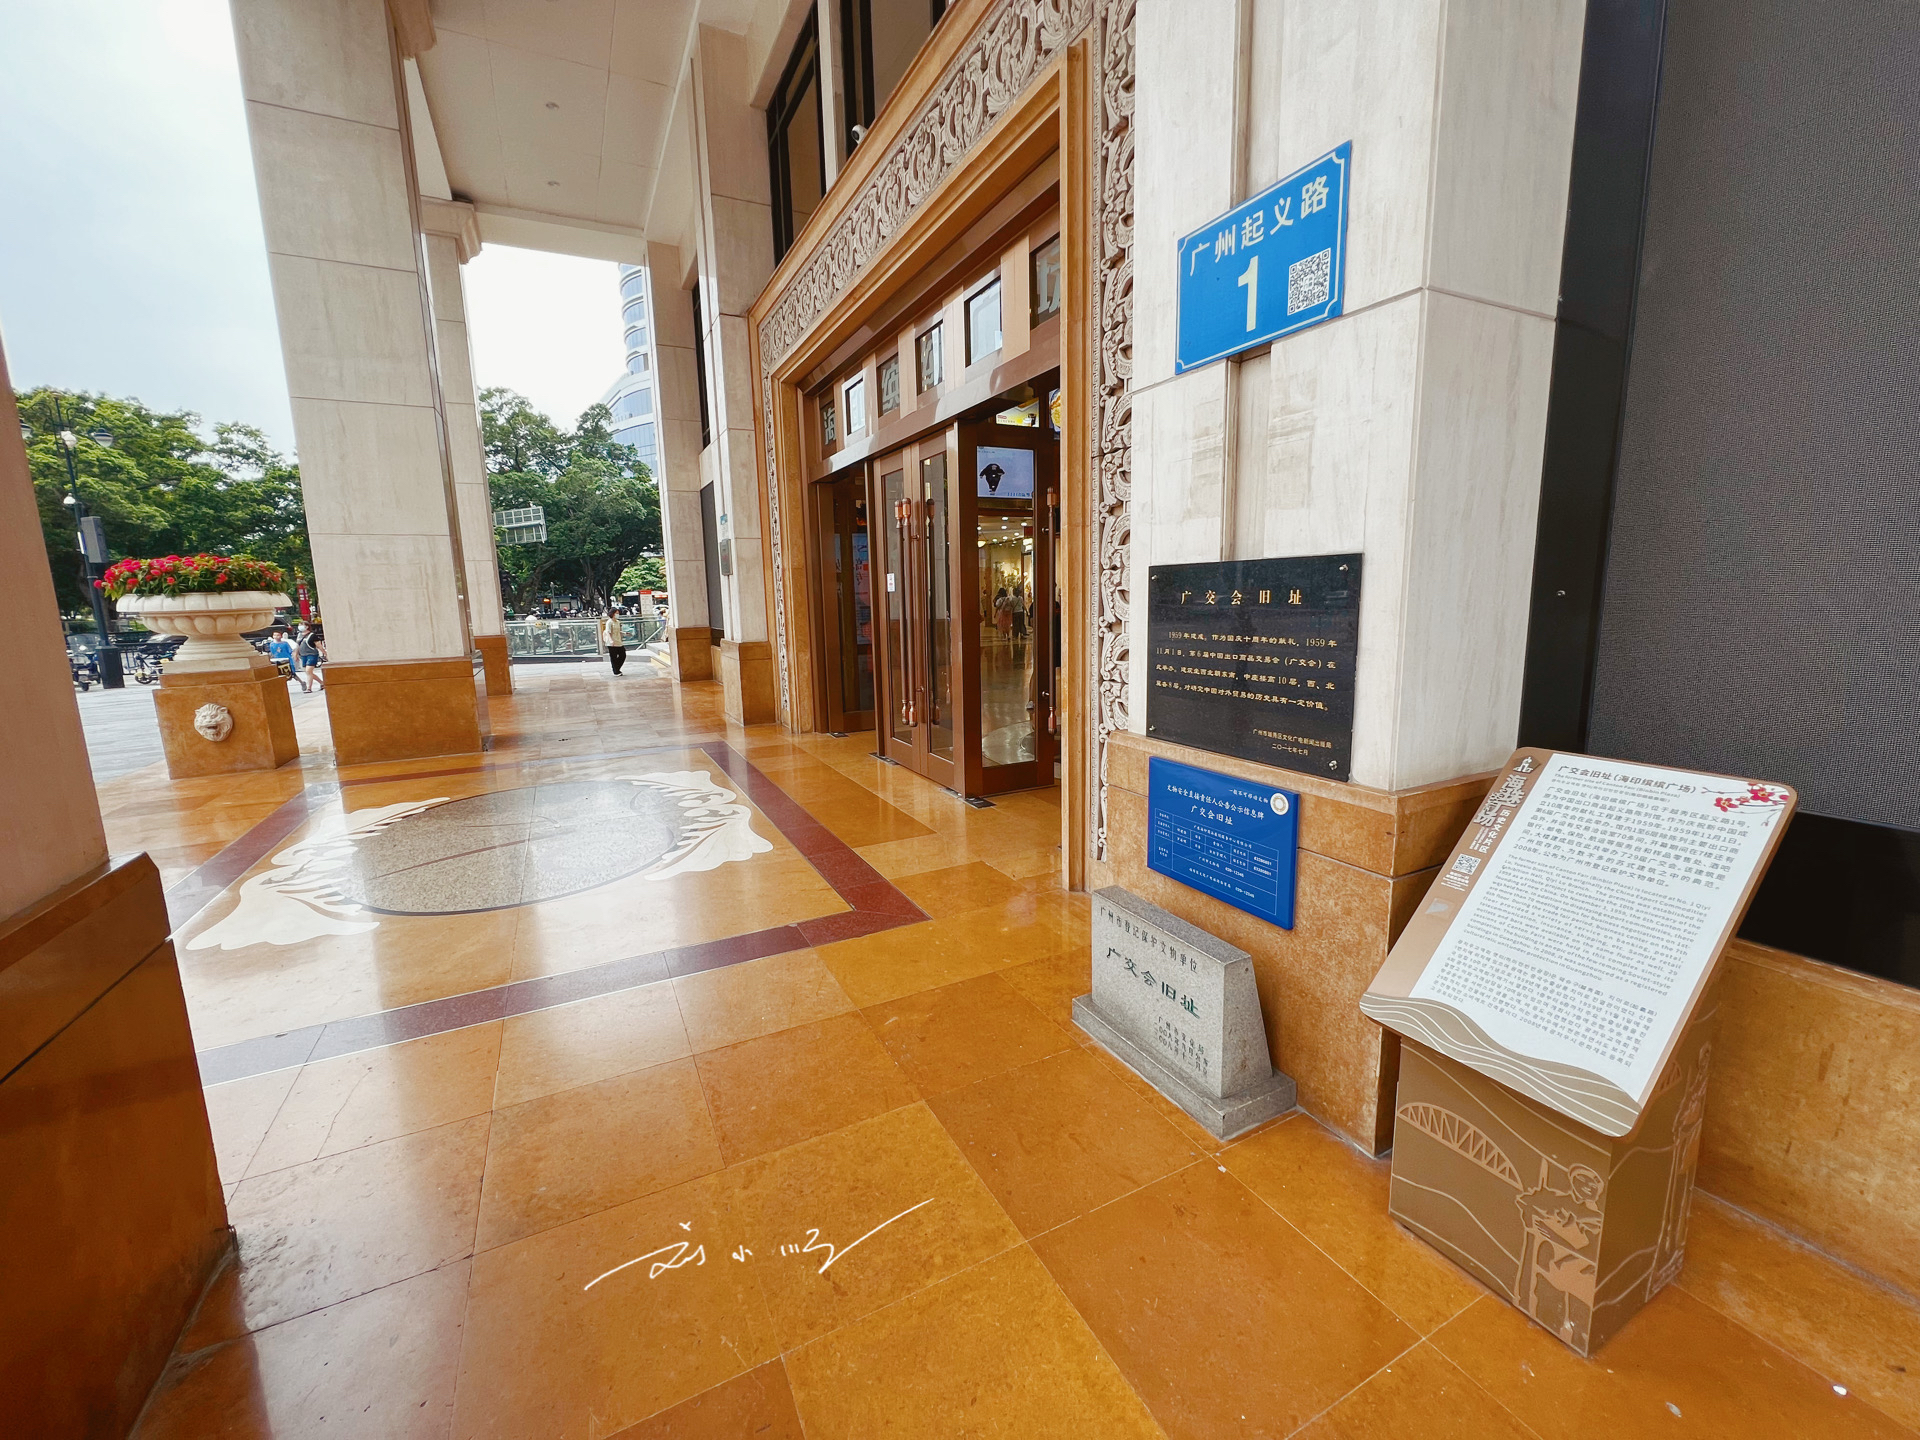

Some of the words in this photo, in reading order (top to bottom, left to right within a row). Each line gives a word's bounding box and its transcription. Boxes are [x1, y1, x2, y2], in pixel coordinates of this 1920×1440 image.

[1190, 175, 1329, 276] 广州起义路
[1238, 255, 1259, 332] 1
[1181, 588, 1302, 605] 广交会旧址
[1166, 784, 1265, 821] 文物安全直接责任人公告公示信息牌
[1190, 804, 1234, 826] 广交会旧址
[1479, 809, 1511, 853] 历史文化片区
[1100, 906, 1198, 973] 广州市登记保护文物单位
[1106, 947, 1200, 1019] 广交会旧址
